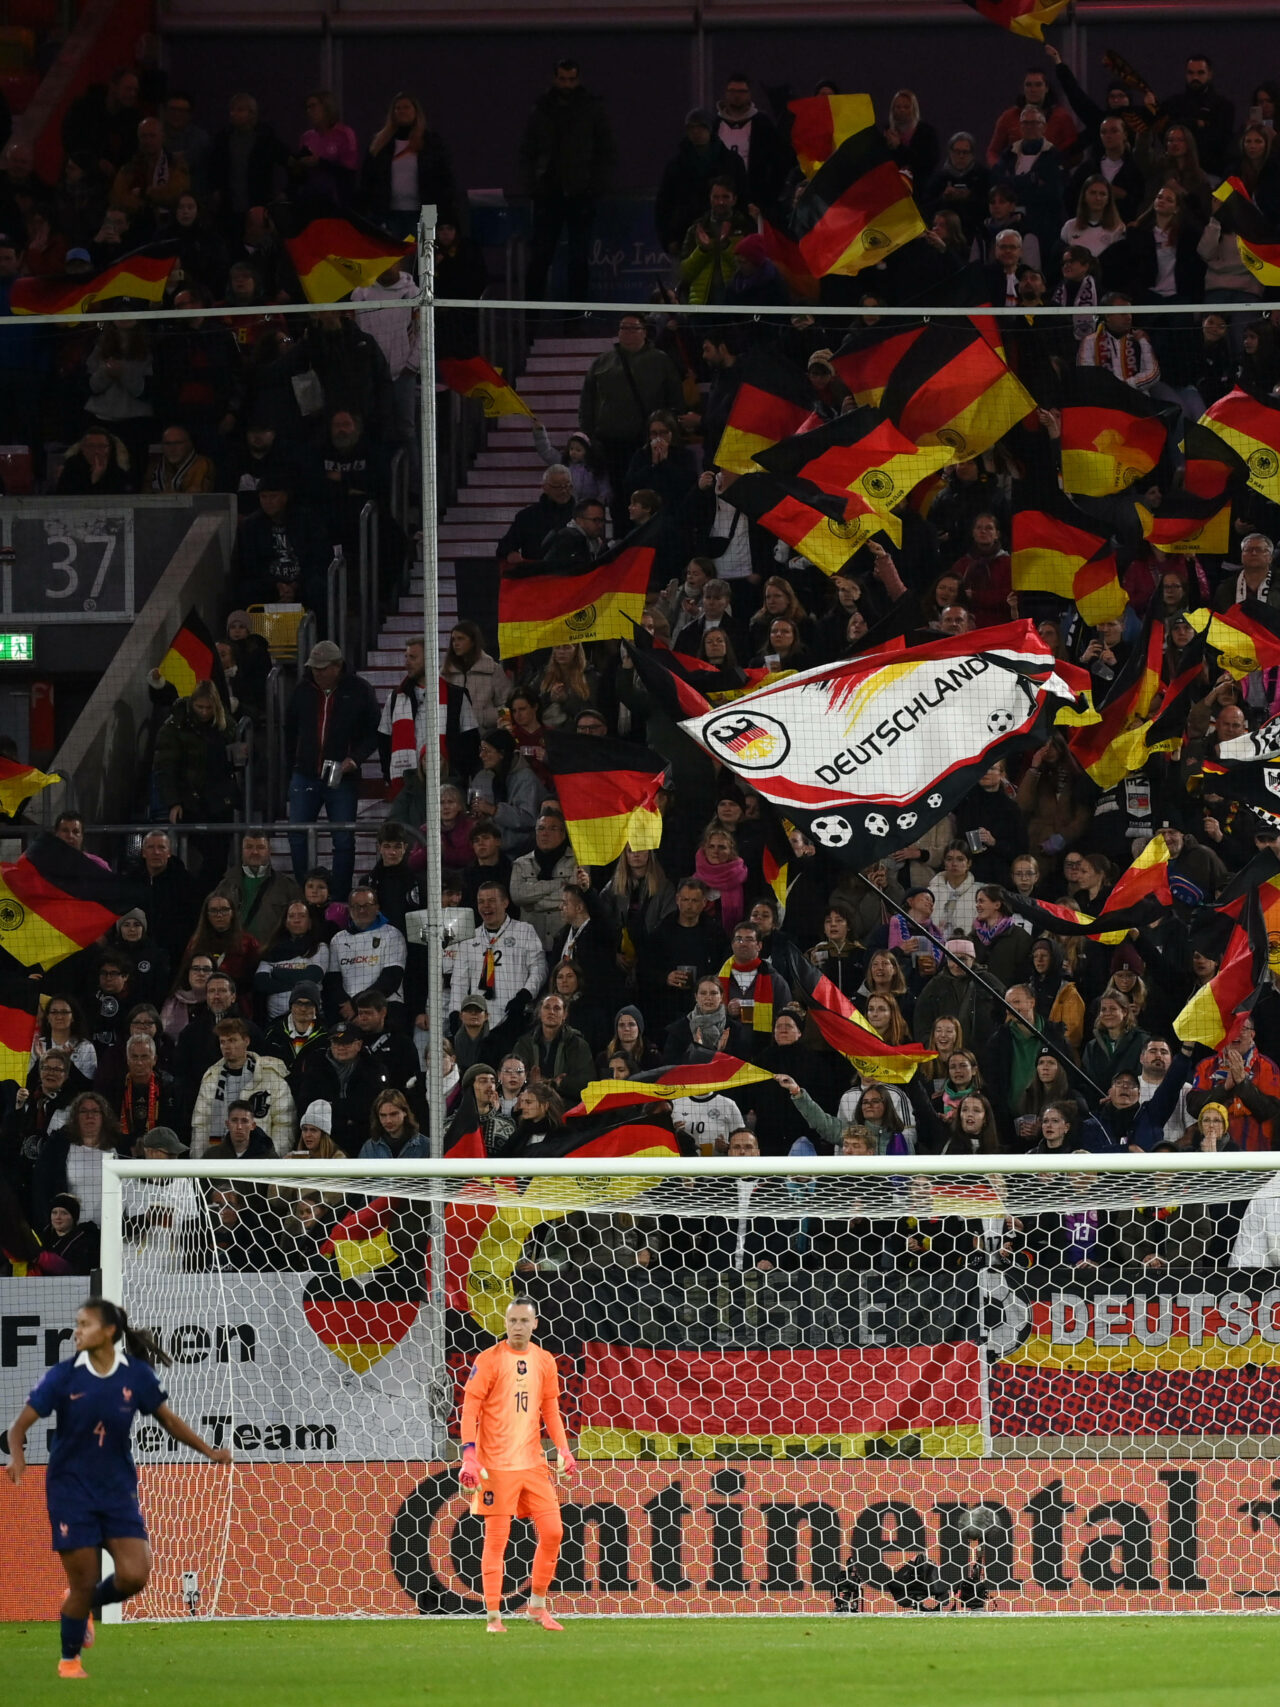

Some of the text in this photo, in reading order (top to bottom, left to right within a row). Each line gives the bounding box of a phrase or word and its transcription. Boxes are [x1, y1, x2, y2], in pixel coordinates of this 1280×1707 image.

[587, 240, 624, 277] lip
[45, 534, 117, 600] 37
[814, 653, 990, 785] DEUTSCHLAND
[340, 954, 379, 967] CHECK24
[691, 1121, 705, 1134] 10
[1073, 1222, 1090, 1241] 13
[1, 1315, 256, 1368] Fren
[514, 1391, 528, 1413] 16
[92, 1421, 107, 1448] 4
[201, 1416, 338, 1451] Team
